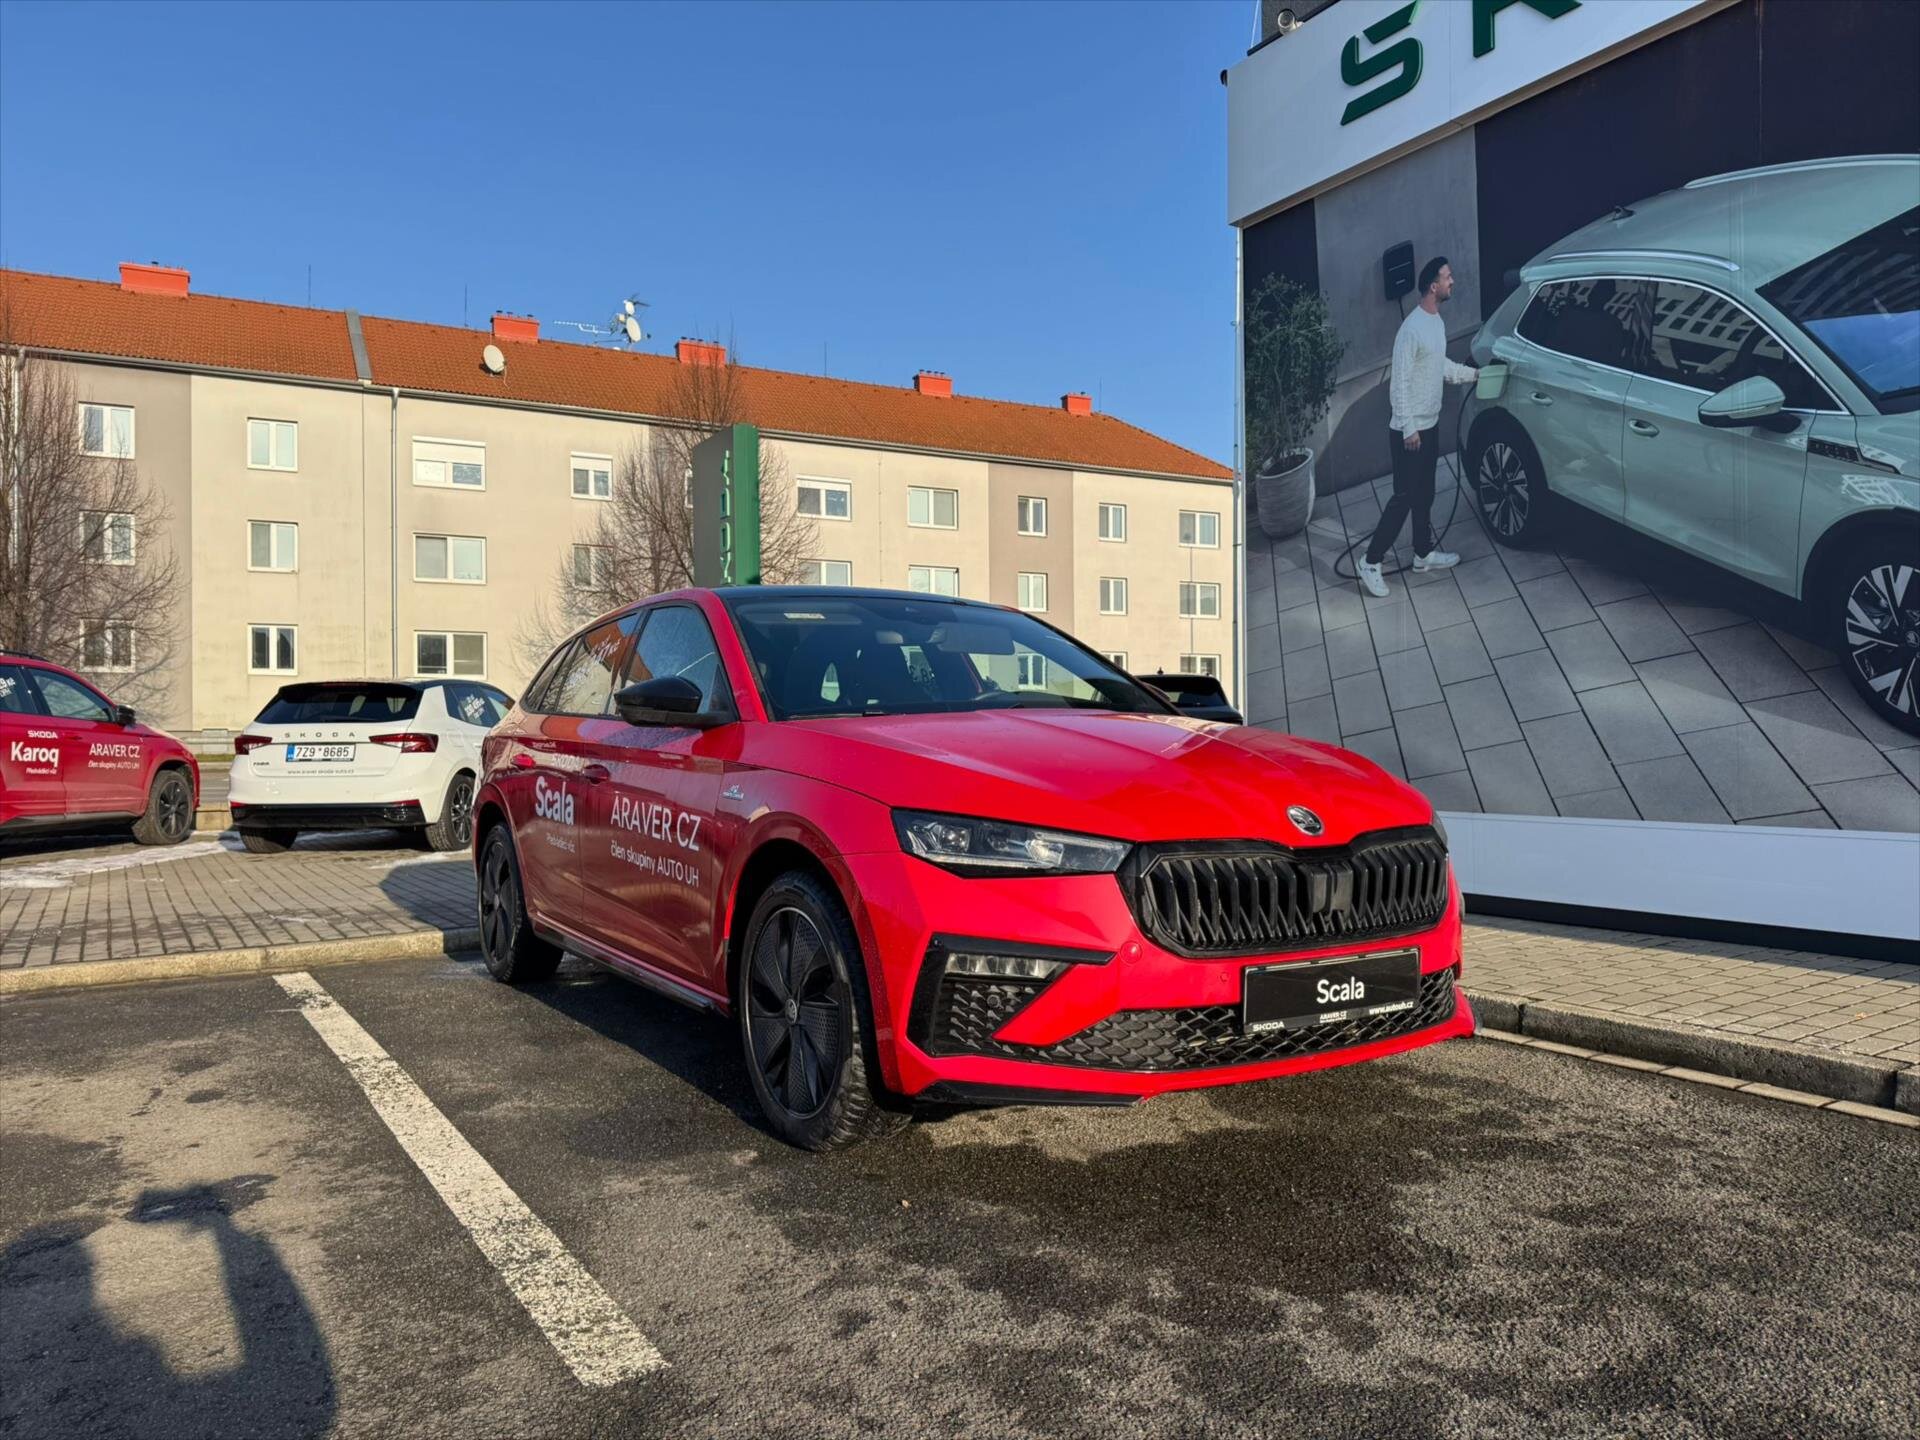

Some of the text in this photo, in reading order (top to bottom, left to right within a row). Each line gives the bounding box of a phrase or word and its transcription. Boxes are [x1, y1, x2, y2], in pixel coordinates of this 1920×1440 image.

[11, 741, 59, 768] Karoq
[89, 743, 140, 758] ARAVER CZ
[295, 746, 350, 758] 7Z9 8685
[535, 775, 575, 826] Scala
[610, 795, 673, 844] ARAVER
[676, 811, 702, 852] CZ
[610, 840, 700, 888] člen skupiny AUTO UH
[1316, 976, 1366, 1004] Scala
